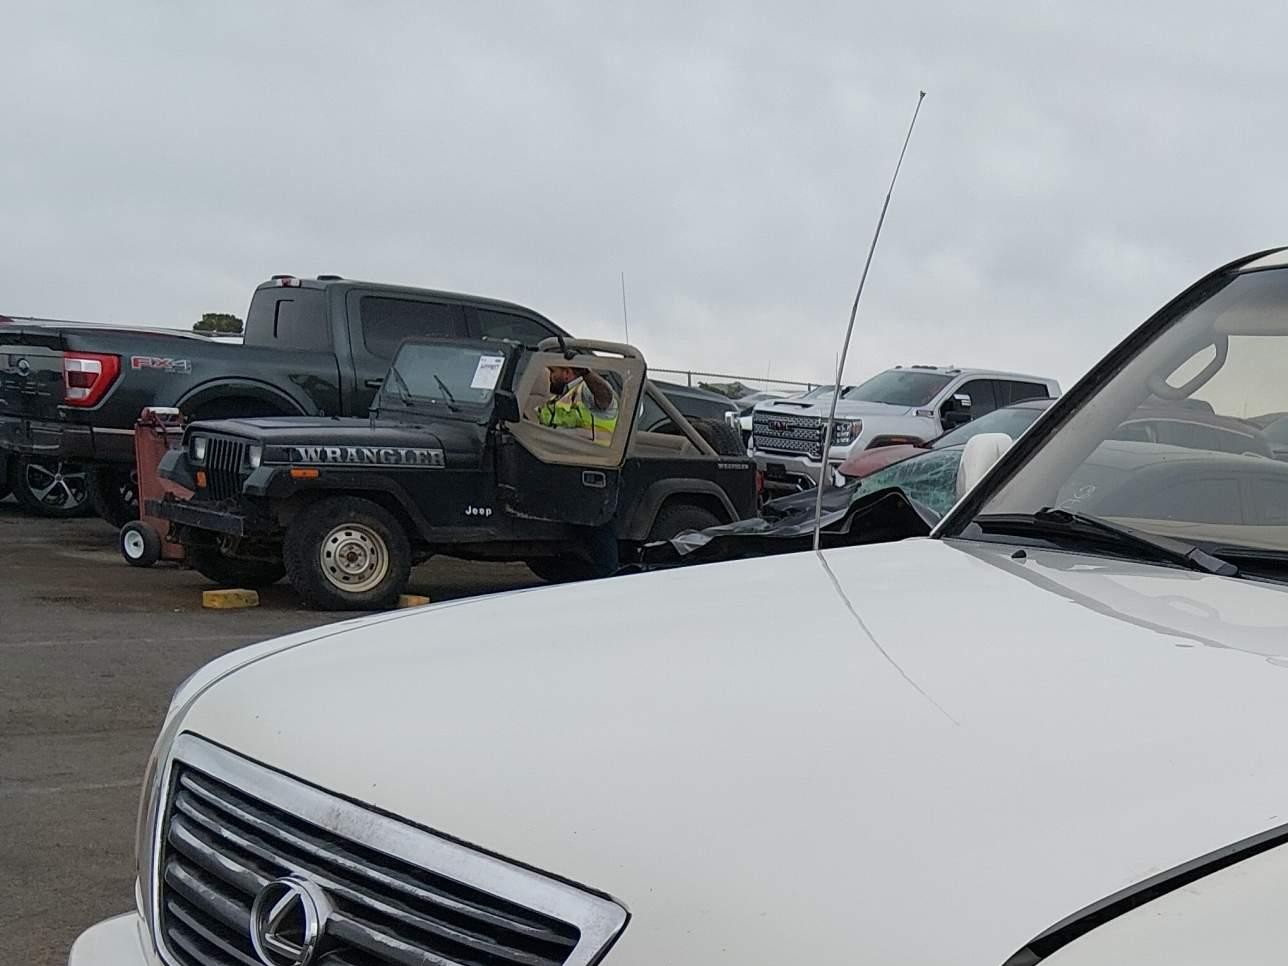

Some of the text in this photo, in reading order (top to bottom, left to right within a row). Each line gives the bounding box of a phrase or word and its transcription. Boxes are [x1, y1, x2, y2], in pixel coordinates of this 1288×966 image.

[131, 356, 187, 369] FX4
[296, 447, 445, 466] WRANGLER
[465, 505, 492, 516] Jeep
